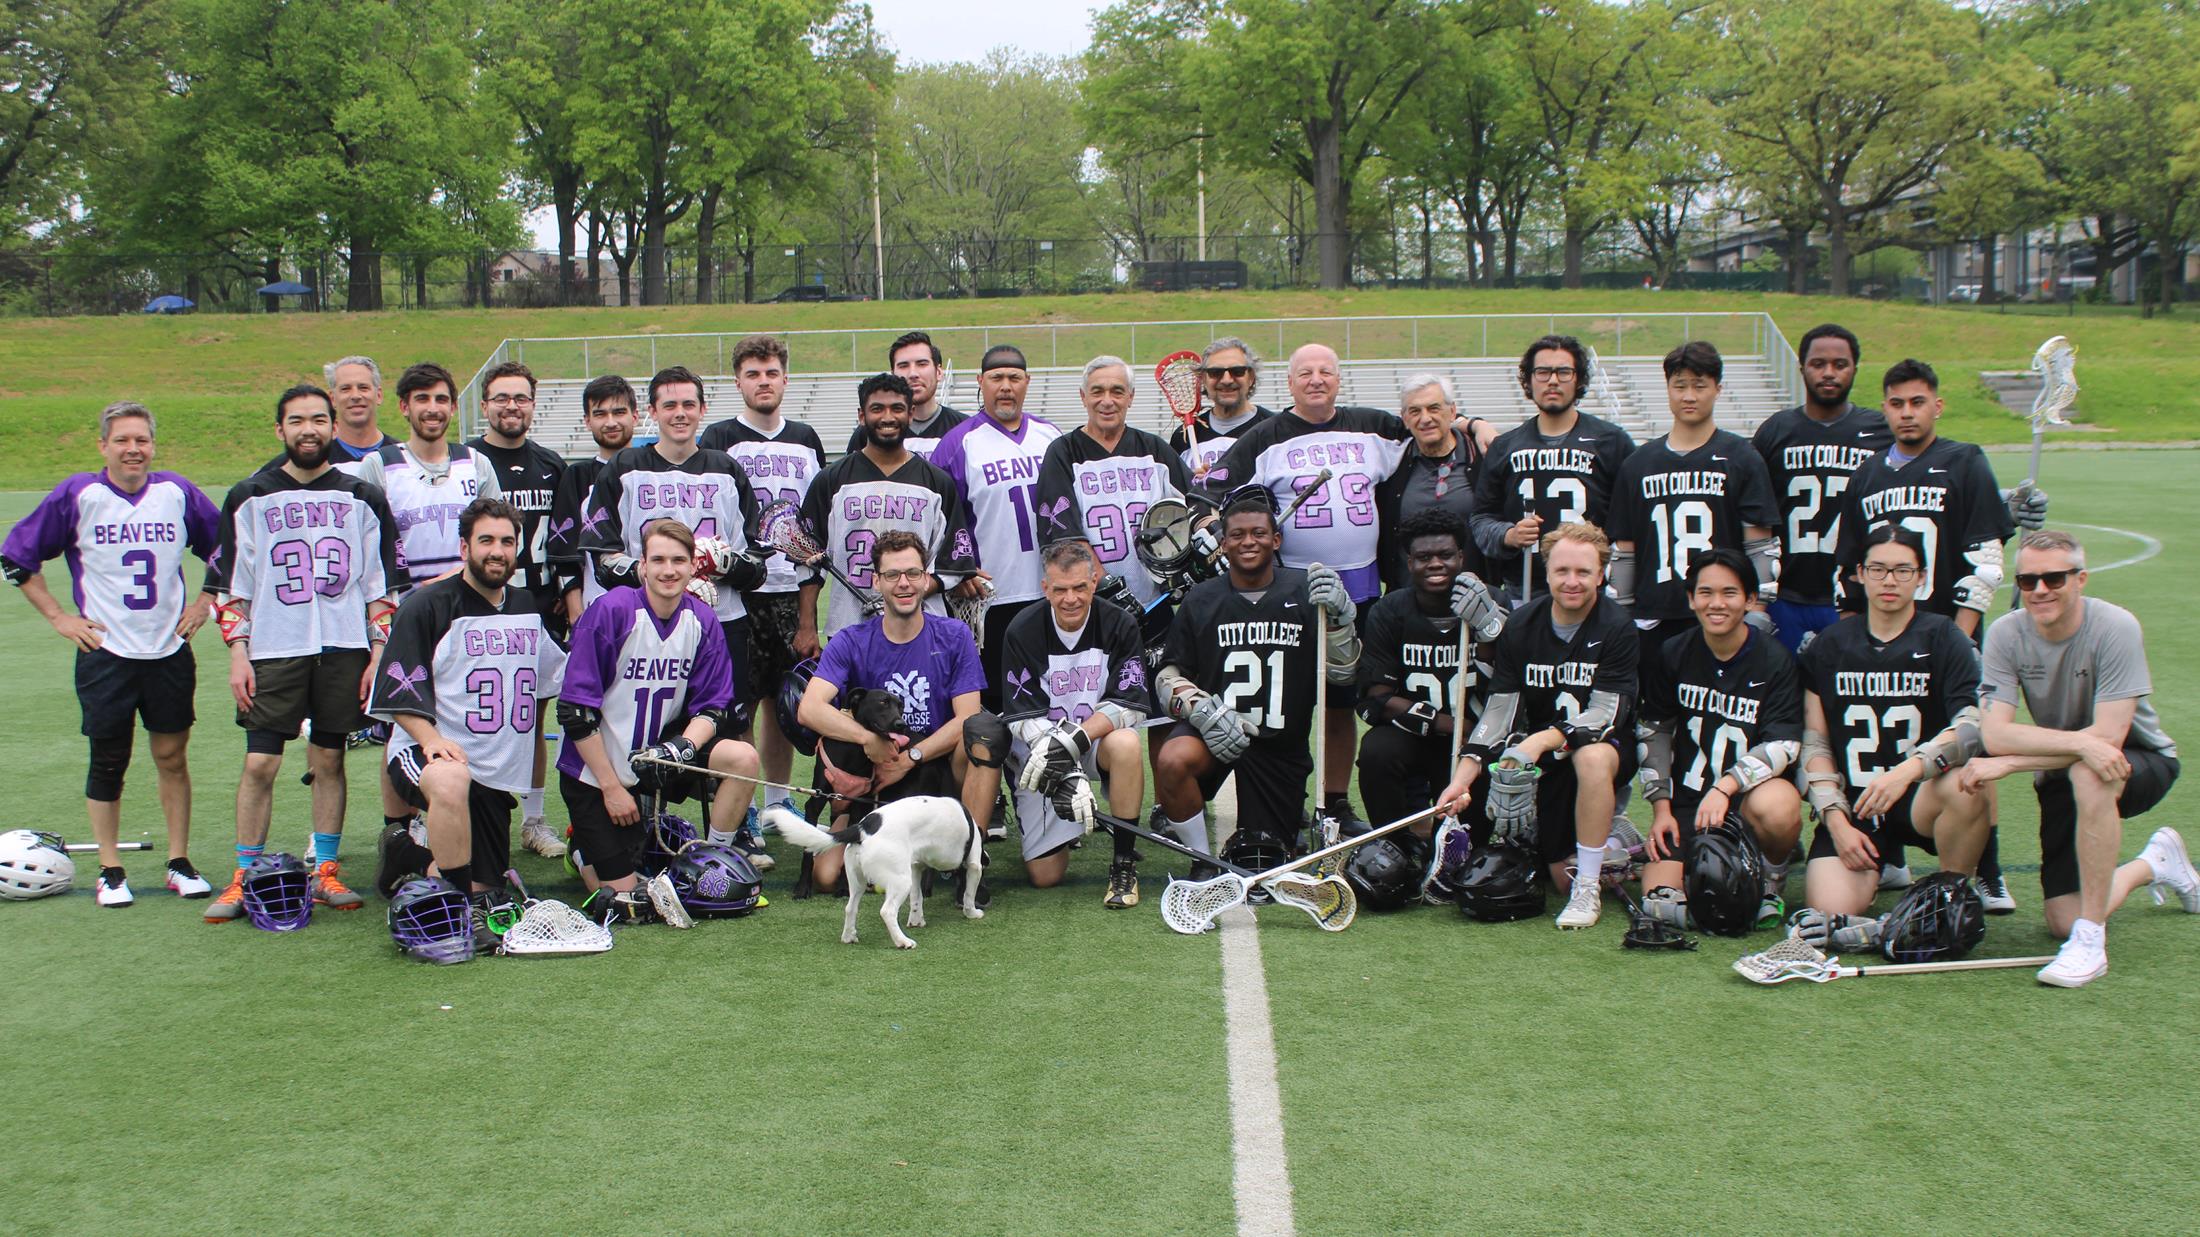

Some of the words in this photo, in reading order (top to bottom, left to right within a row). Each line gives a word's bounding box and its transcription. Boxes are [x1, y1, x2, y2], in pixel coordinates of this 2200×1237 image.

[736, 455, 807, 479] CCNY
[982, 455, 1043, 486] BEAV
[1287, 442, 1365, 471] CCNY
[1511, 449, 1537, 474] CITY
[1538, 449, 1595, 475] COLLEGE
[1783, 446, 1814, 470] CITY
[461, 479, 477, 496] 18
[1080, 467, 1154, 495] CCNY
[1641, 473, 1669, 499] CITY
[1669, 471, 1727, 497] COLLEGE
[638, 483, 718, 509] CCNY
[844, 495, 928, 522] CCNY
[1290, 473, 1374, 529] 29
[1884, 486, 1948, 512] COLLEGE
[264, 502, 352, 533] CCNY
[393, 504, 467, 538] BEAVE
[1788, 475, 1850, 555] 27
[95, 522, 176, 545] BEAVERS
[1651, 501, 1713, 584] 18
[122, 550, 157, 610] 3
[271, 537, 350, 606] 33
[465, 628, 539, 657] CCNY
[1217, 623, 1245, 647] CITY
[1247, 621, 1303, 647] COLLEGE
[623, 658, 691, 680] BEAVES
[1403, 643, 1433, 668] CITY
[1223, 650, 1285, 729] 21
[1526, 663, 1555, 688] CITY
[1836, 672, 1866, 697] CITY
[1866, 672, 1931, 697] COLLEGE
[465, 667, 537, 735] 36
[1678, 682, 1709, 712] CITY
[1708, 690, 1760, 725] COLLEGE
[902, 712, 931, 726] ROSSE
[1683, 716, 1748, 792] 10
[1843, 704, 1922, 788] 23
